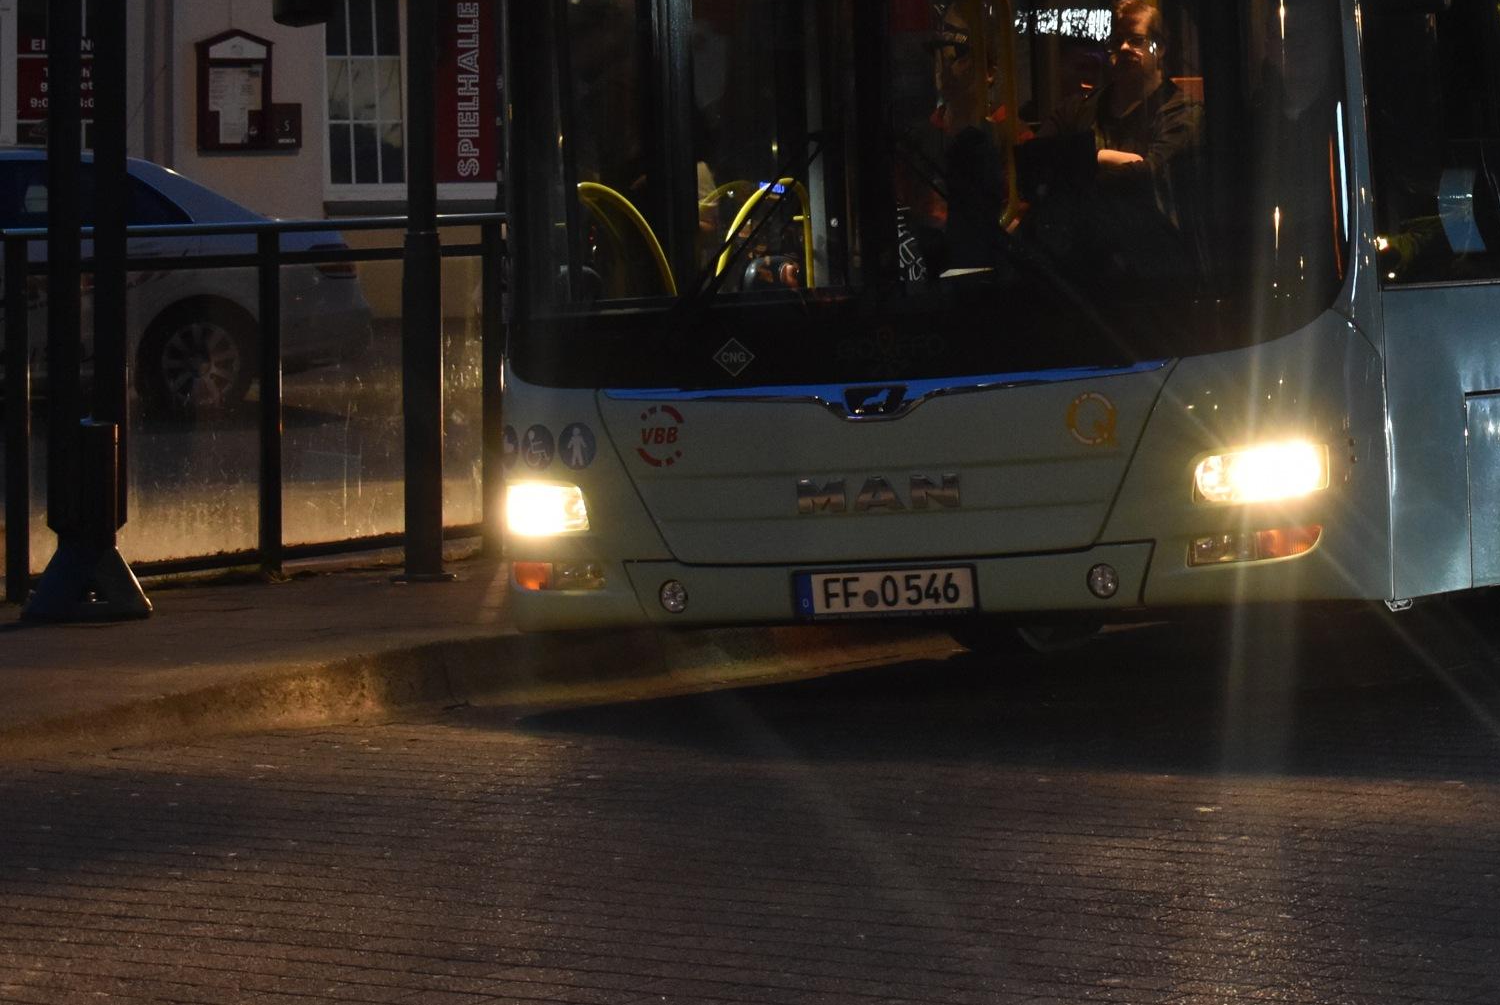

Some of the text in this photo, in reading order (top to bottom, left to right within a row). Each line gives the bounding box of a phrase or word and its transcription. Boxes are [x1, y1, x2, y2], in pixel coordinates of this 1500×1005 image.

[457, 2, 480, 177] SPIELHALLE
[720, 351, 746, 364] CNG
[641, 426, 678, 445] VBB
[797, 472, 960, 515] MAN
